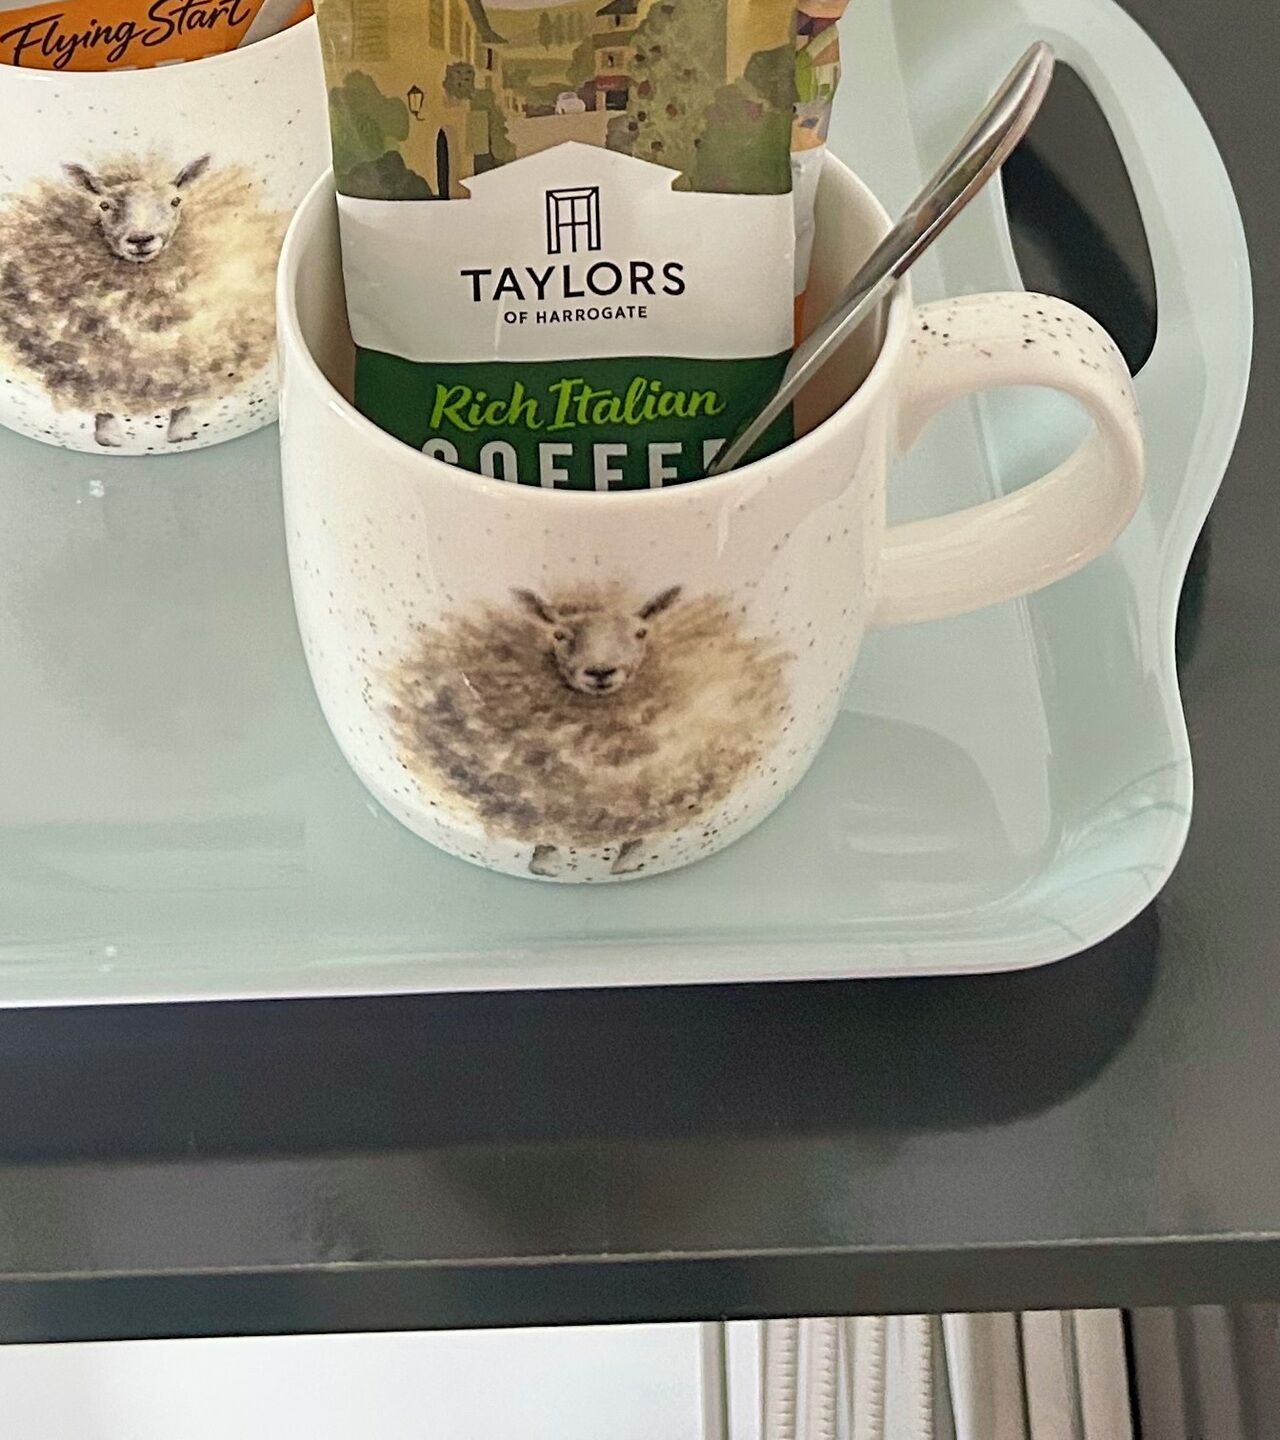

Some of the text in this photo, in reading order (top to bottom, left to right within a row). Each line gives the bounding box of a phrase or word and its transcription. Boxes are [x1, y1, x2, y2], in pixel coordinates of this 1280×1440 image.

[0, 11, 141, 68] Flying
[460, 261, 686, 302] TAYLORS
[504, 305, 648, 325] OF HARROGATE
[429, 375, 727, 431] Rich Italian
[422, 438, 726, 490] OFFE
